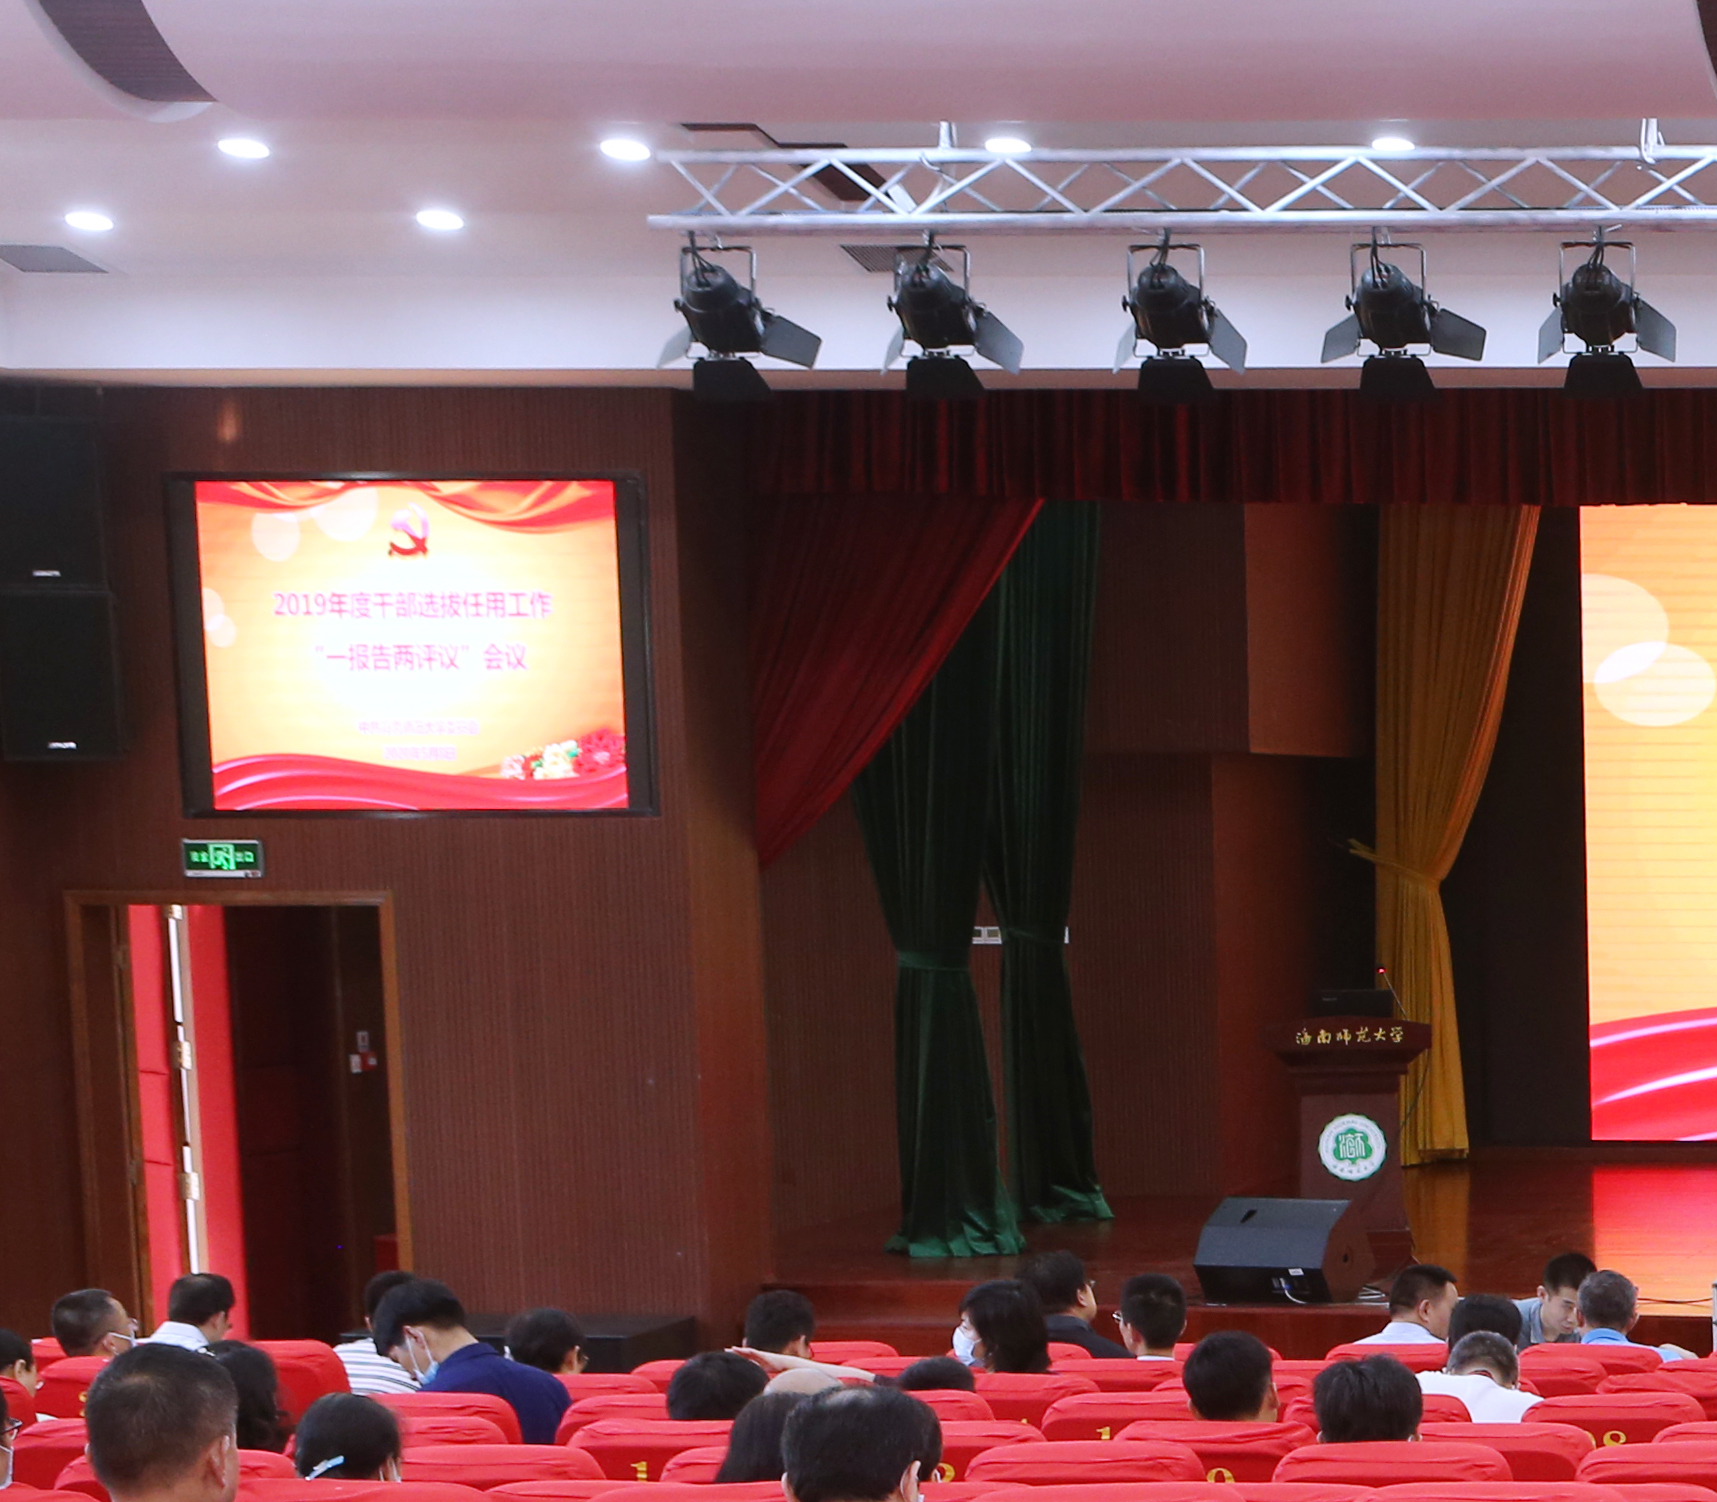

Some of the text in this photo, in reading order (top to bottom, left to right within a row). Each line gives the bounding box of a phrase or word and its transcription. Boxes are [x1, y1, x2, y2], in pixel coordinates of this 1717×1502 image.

[272, 591, 553, 619] 2019年度干部选拔任用工作
